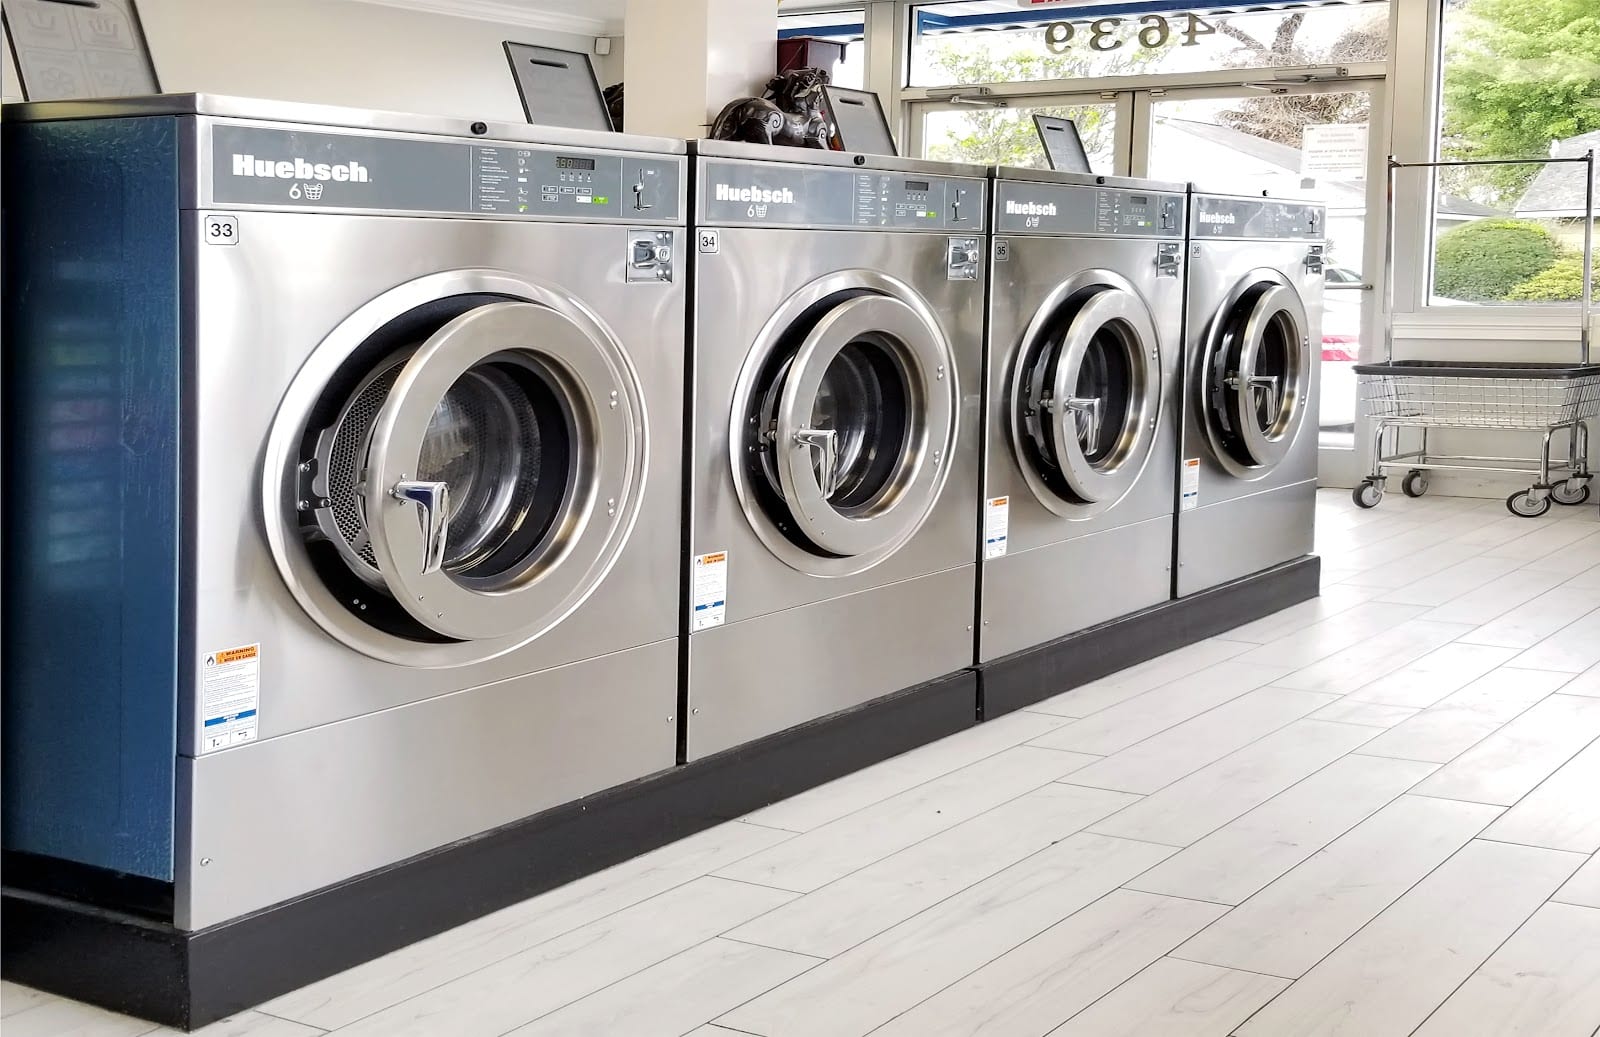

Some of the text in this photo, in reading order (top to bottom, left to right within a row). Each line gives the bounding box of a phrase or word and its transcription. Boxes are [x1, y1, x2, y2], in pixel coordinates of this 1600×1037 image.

[232, 153, 369, 183] Huebsch
[289, 183, 301, 200] 6
[716, 183, 794, 204] Huebsch
[747, 205, 755, 218] 6
[1005, 200, 1057, 216] Huebsch
[1025, 217, 1032, 227] 6
[1199, 211, 1236, 225] Huebsch
[210, 222, 234, 238] 33
[702, 235, 715, 248] 34
[996, 246, 1006, 255] 35
